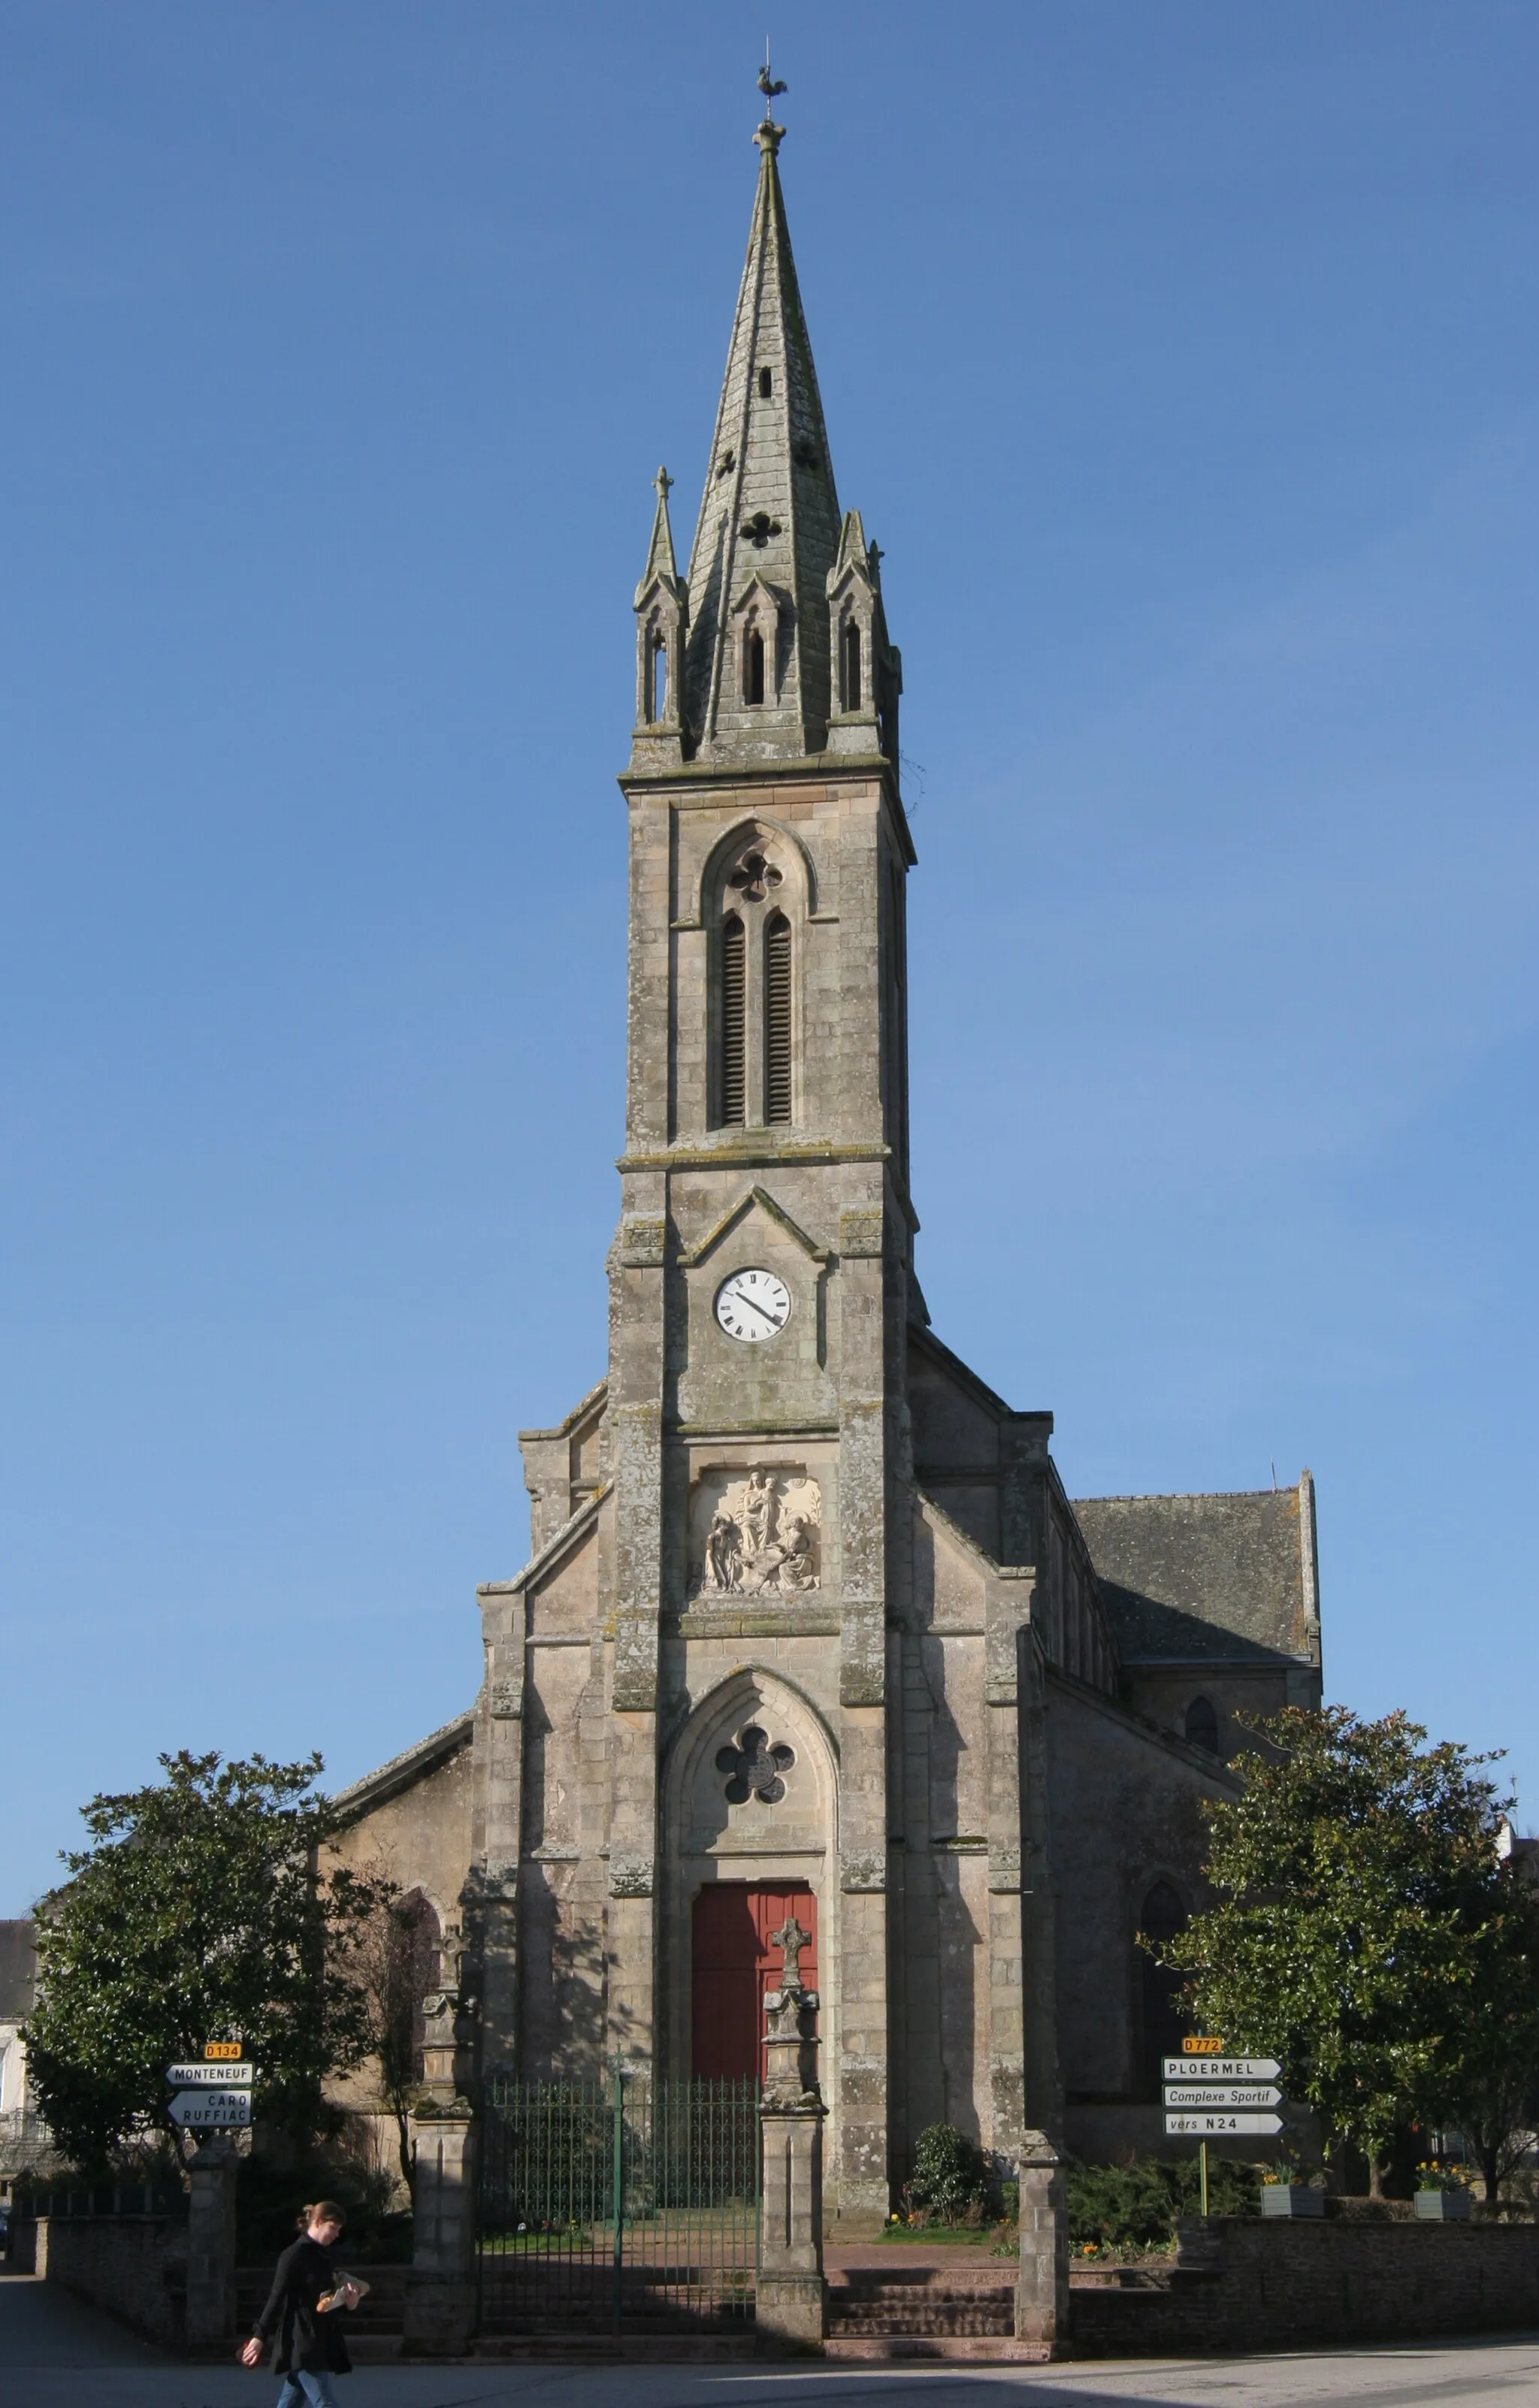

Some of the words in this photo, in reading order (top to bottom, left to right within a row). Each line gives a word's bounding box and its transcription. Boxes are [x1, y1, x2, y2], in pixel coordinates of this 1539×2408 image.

[174, 2068, 248, 2080] MONTENEUF
[1169, 2063, 1253, 2074] PLOERMEL
[208, 2095, 246, 2106] CARO
[1170, 2091, 1225, 2104] Complexe
[1231, 2090, 1270, 2104] Sportif
[183, 2110, 246, 2121] RUFFIAC
[1171, 2120, 1197, 2129] vers
